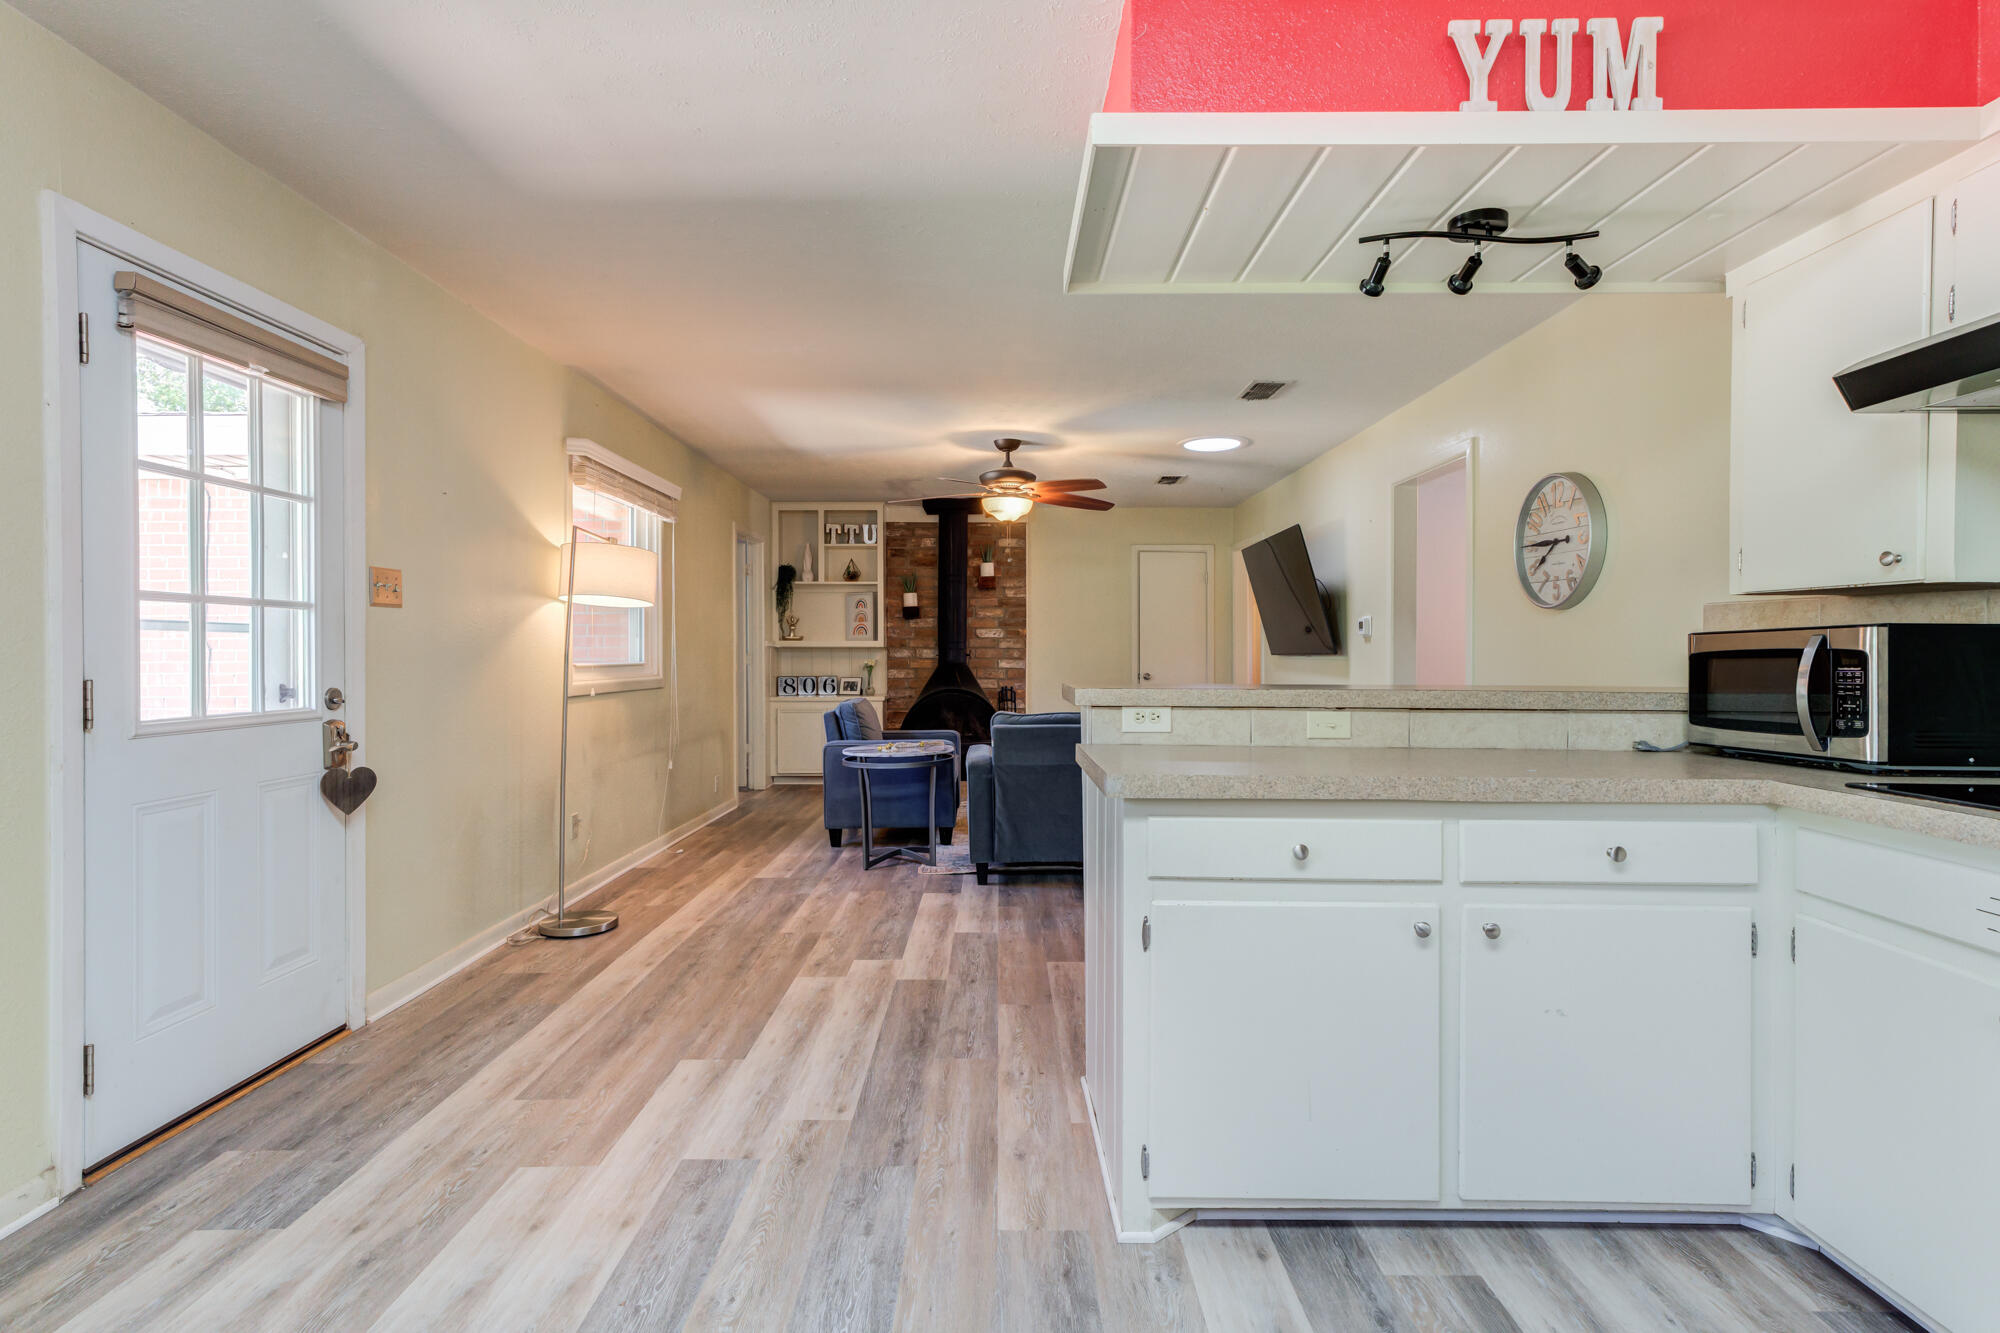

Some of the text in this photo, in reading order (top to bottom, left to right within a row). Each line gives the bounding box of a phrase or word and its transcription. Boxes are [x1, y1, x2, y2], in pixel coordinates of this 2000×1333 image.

[1448, 16, 1664, 111] YUM
[1537, 491, 1550, 518] 11
[1551, 481, 1564, 509] 12
[1567, 485, 1577, 510] 1
[826, 523, 878, 545] TTU
[1527, 511, 1543, 535] 10
[1537, 568, 1551, 594] 7
[782, 677, 836, 694] 806
